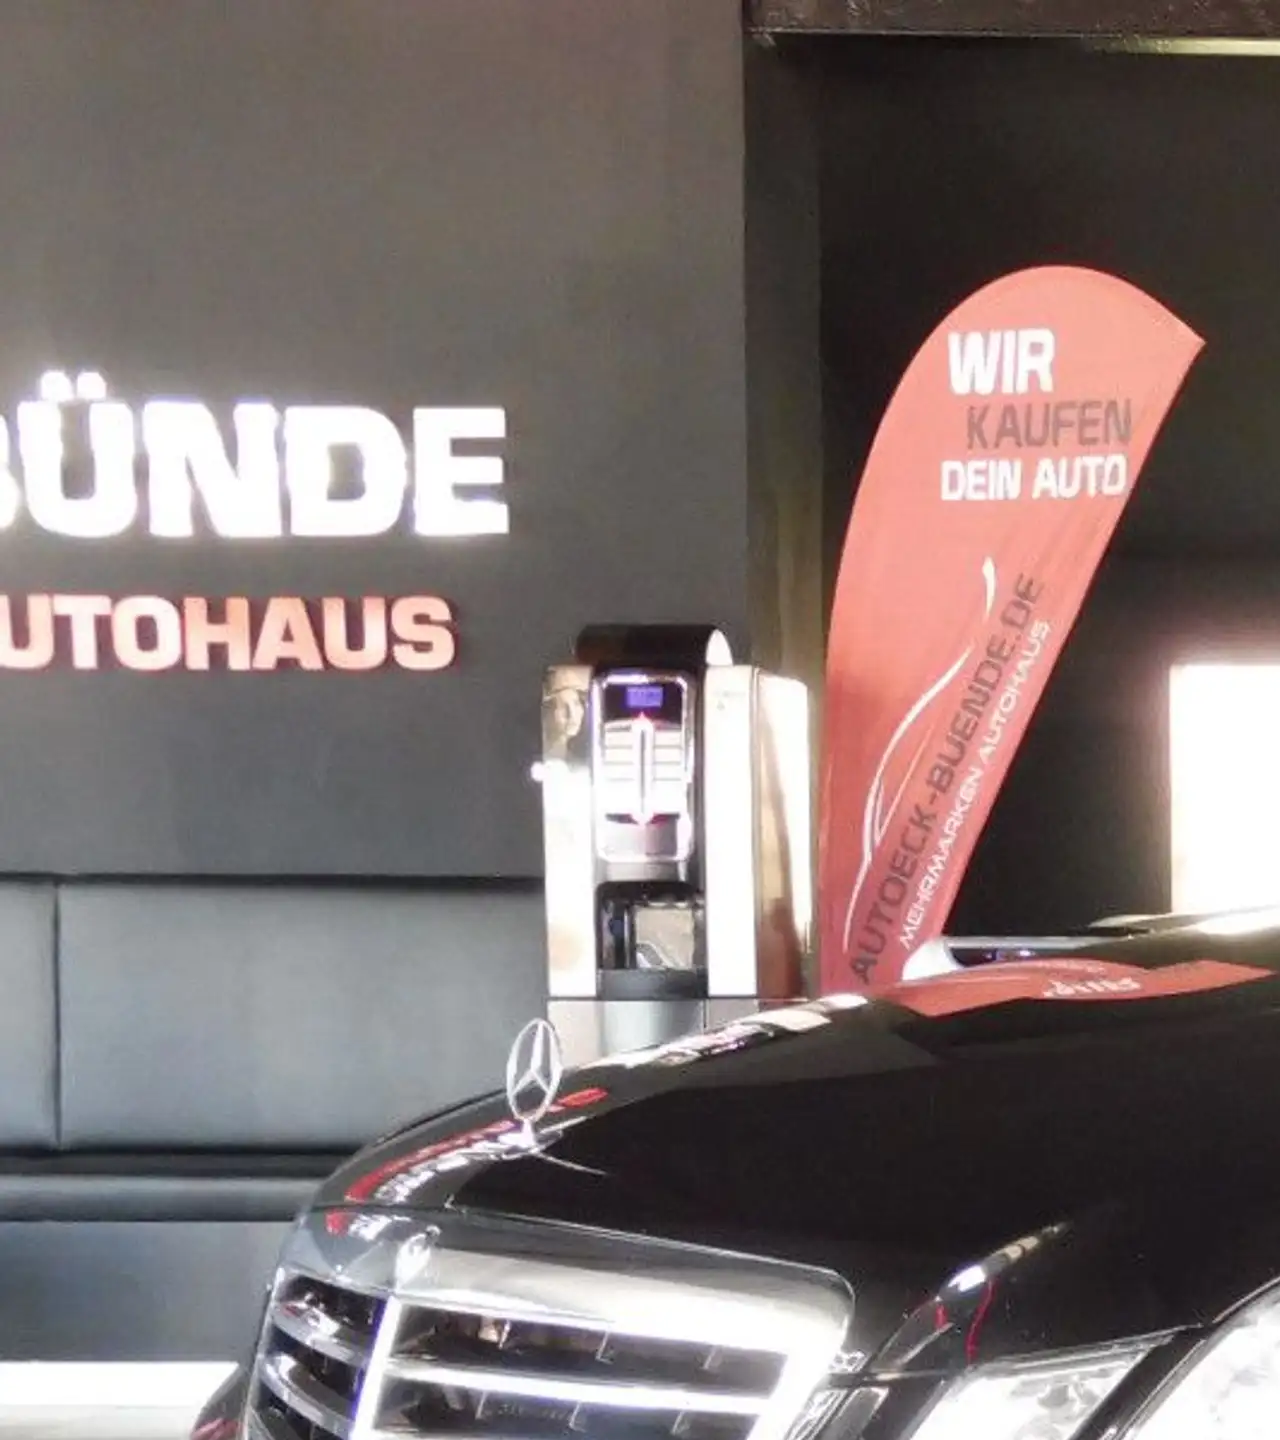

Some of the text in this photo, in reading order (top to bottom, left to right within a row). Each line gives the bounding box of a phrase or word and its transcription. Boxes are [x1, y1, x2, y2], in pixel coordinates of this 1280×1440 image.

[947, 328, 1055, 395] WIR
[0, 370, 509, 537] ÜNDE
[940, 454, 1128, 501] DEIN AUTO
[966, 399, 1132, 450] KAUFEN
[850, 572, 1044, 986] AUTOECK-BUENDE.DE
[899, 618, 1052, 952] MEHRMARKEN AUTOHAUS
